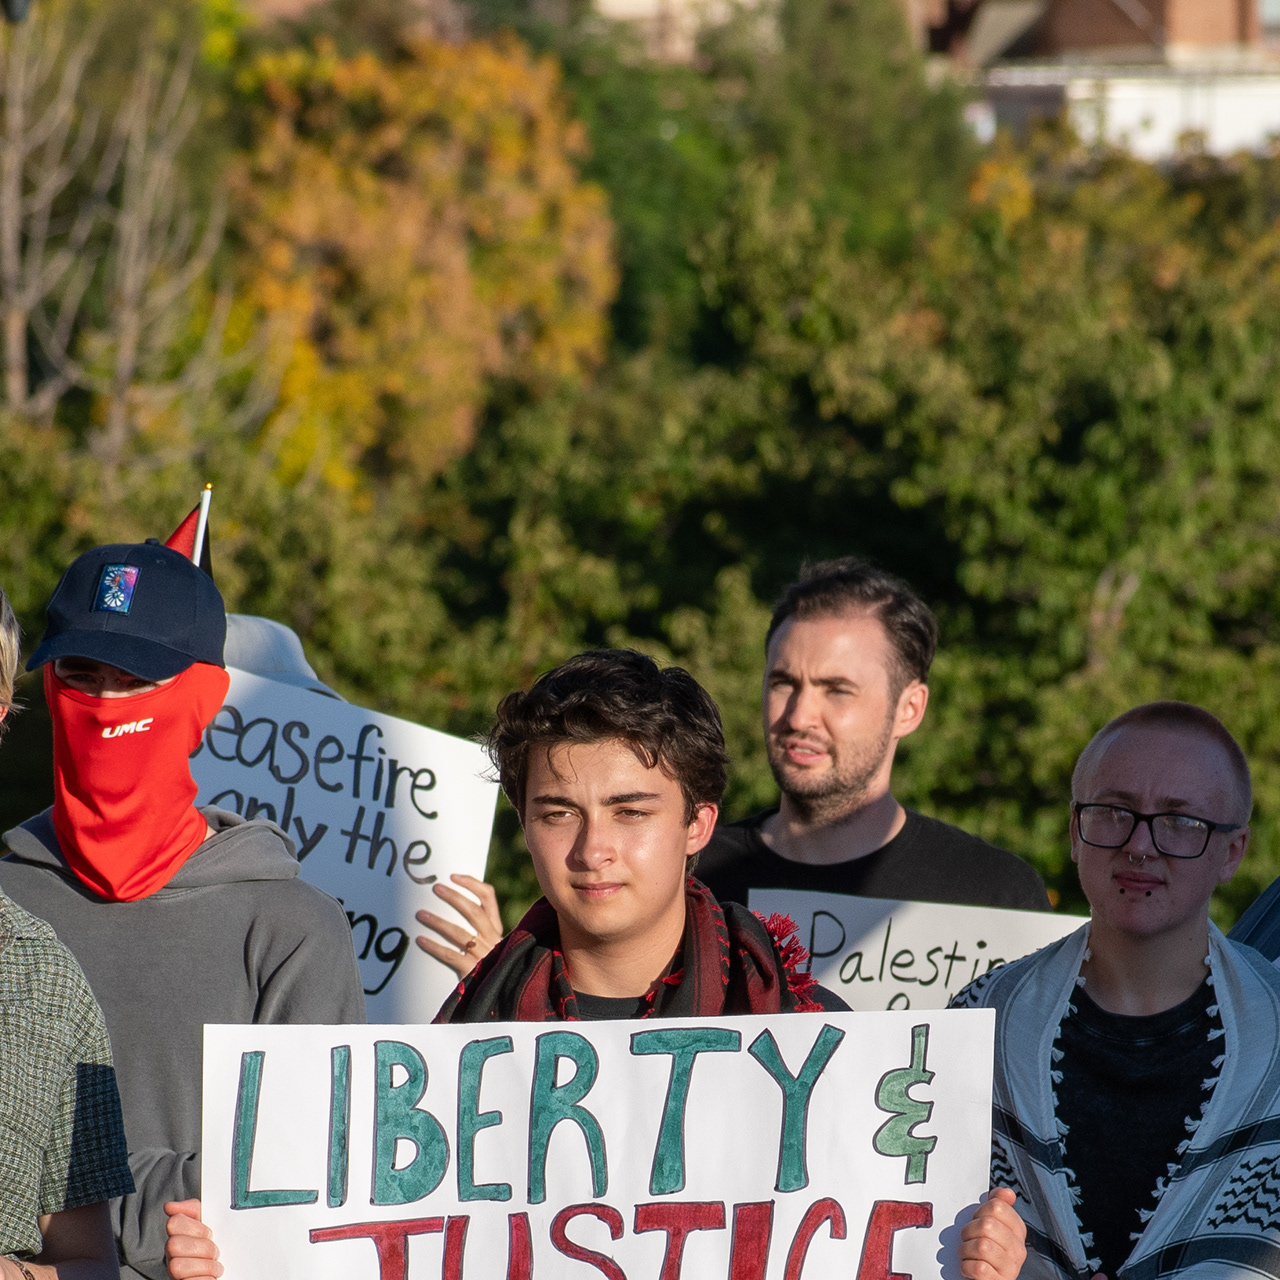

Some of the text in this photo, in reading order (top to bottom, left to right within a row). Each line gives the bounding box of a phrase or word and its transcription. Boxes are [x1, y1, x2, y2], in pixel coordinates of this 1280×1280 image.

[101, 717, 154, 739] UMC
[188, 705, 438, 819] easefire
[340, 805, 438, 885] the
[230, 1025, 846, 1210] LIBERTY
